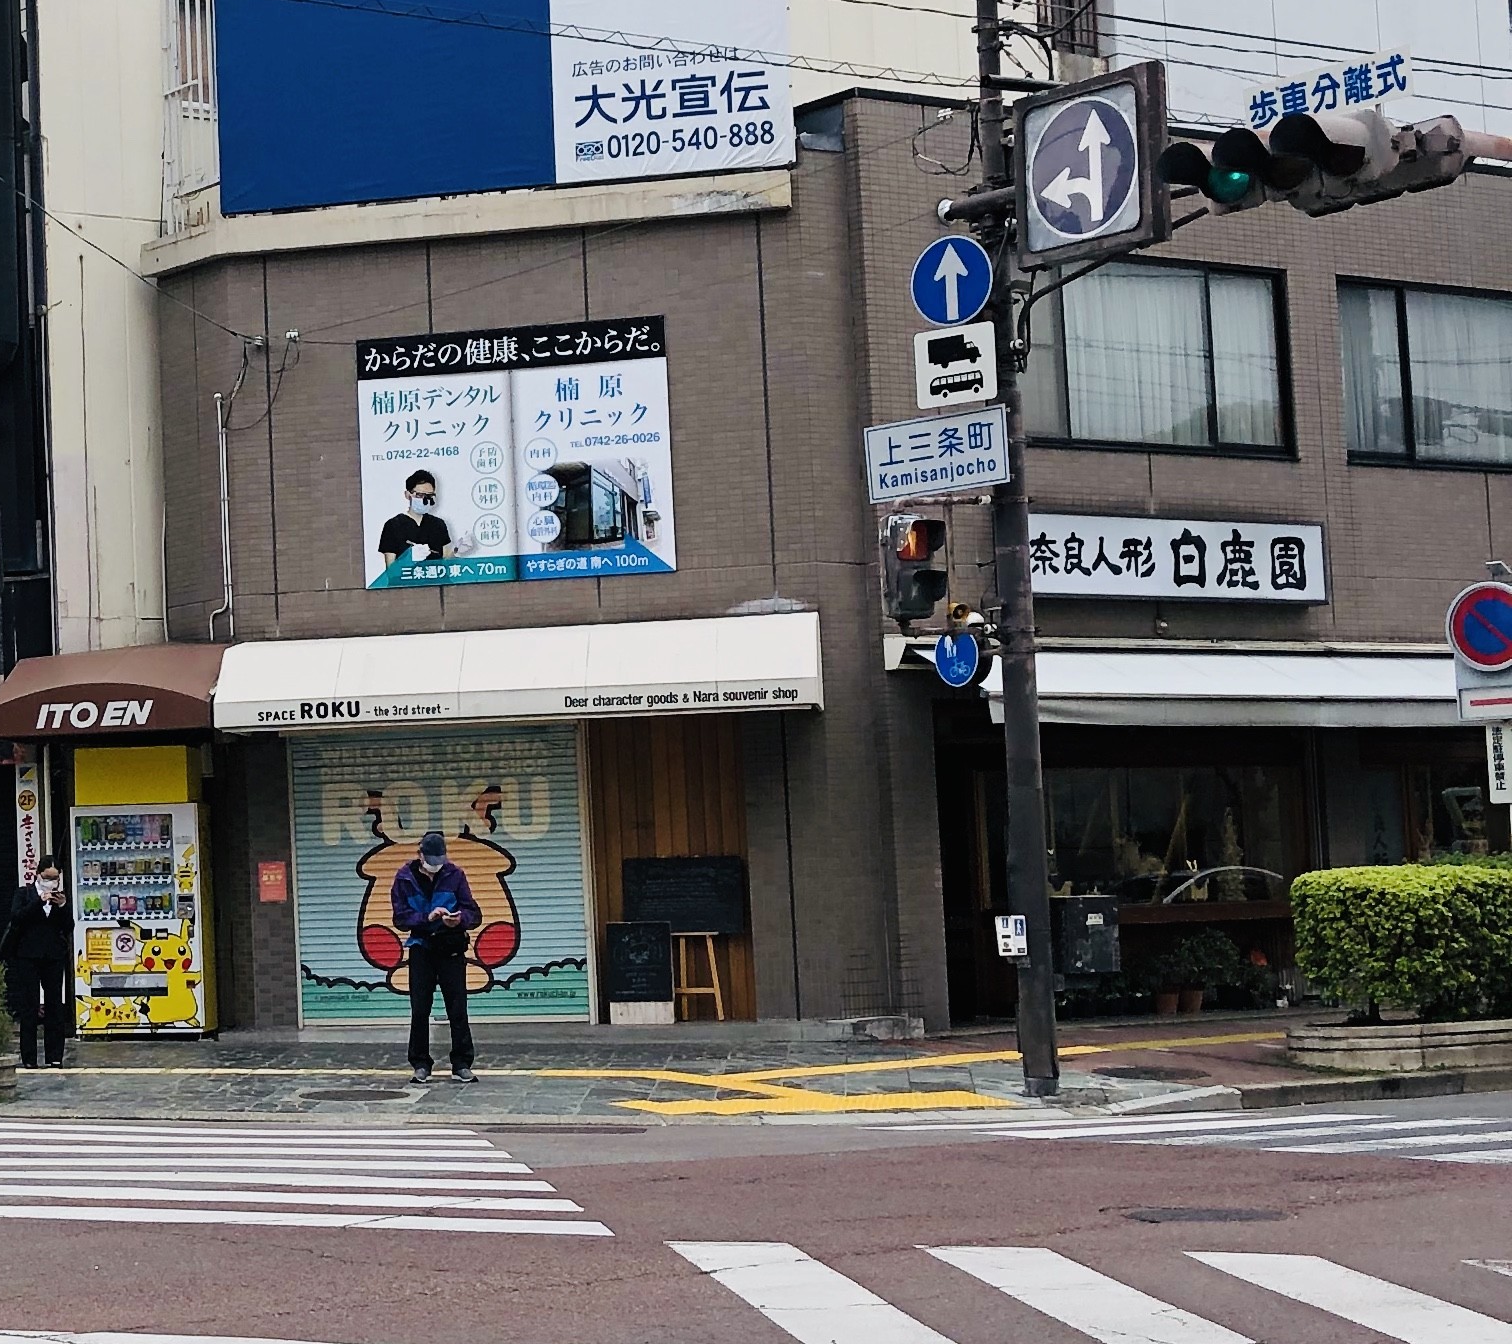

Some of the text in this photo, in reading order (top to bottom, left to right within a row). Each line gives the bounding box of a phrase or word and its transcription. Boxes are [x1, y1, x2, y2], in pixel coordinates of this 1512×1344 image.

[571, 46, 739, 78] 広告のお問い合わせは
[574, 69, 771, 128] 大光宣伝
[1249, 53, 1407, 129] 歩車分離式
[607, 120, 775, 158] 0120-540-888
[364, 325, 662, 373] からだの健康、ここからだ。
[370, 384, 503, 416] 楠原デンタル
[383, 413, 490, 443] クリニック
[534, 402, 649, 432] クリニック
[386, 445, 460, 461] 0742-22-4168
[570, 431, 661, 448] TEL 0742-26-0026
[878, 422, 994, 467] 上三条町
[879, 457, 997, 490] Kamisanjocho
[400, 562, 507, 581] 三条通り 東へ 70m
[526, 554, 649, 574] やすらぎの道 南へ 100m
[1029, 527, 1308, 592] 奈良人形 白鹿園
[257, 700, 441, 723] SPACE ROKU the 3rd street
[564, 686, 799, 708] Deer character goods & Nara souvenir shop
[35, 700, 154, 729] ITO EN
[20, 794, 34, 806] 2F
[321, 775, 551, 847] ROKU
